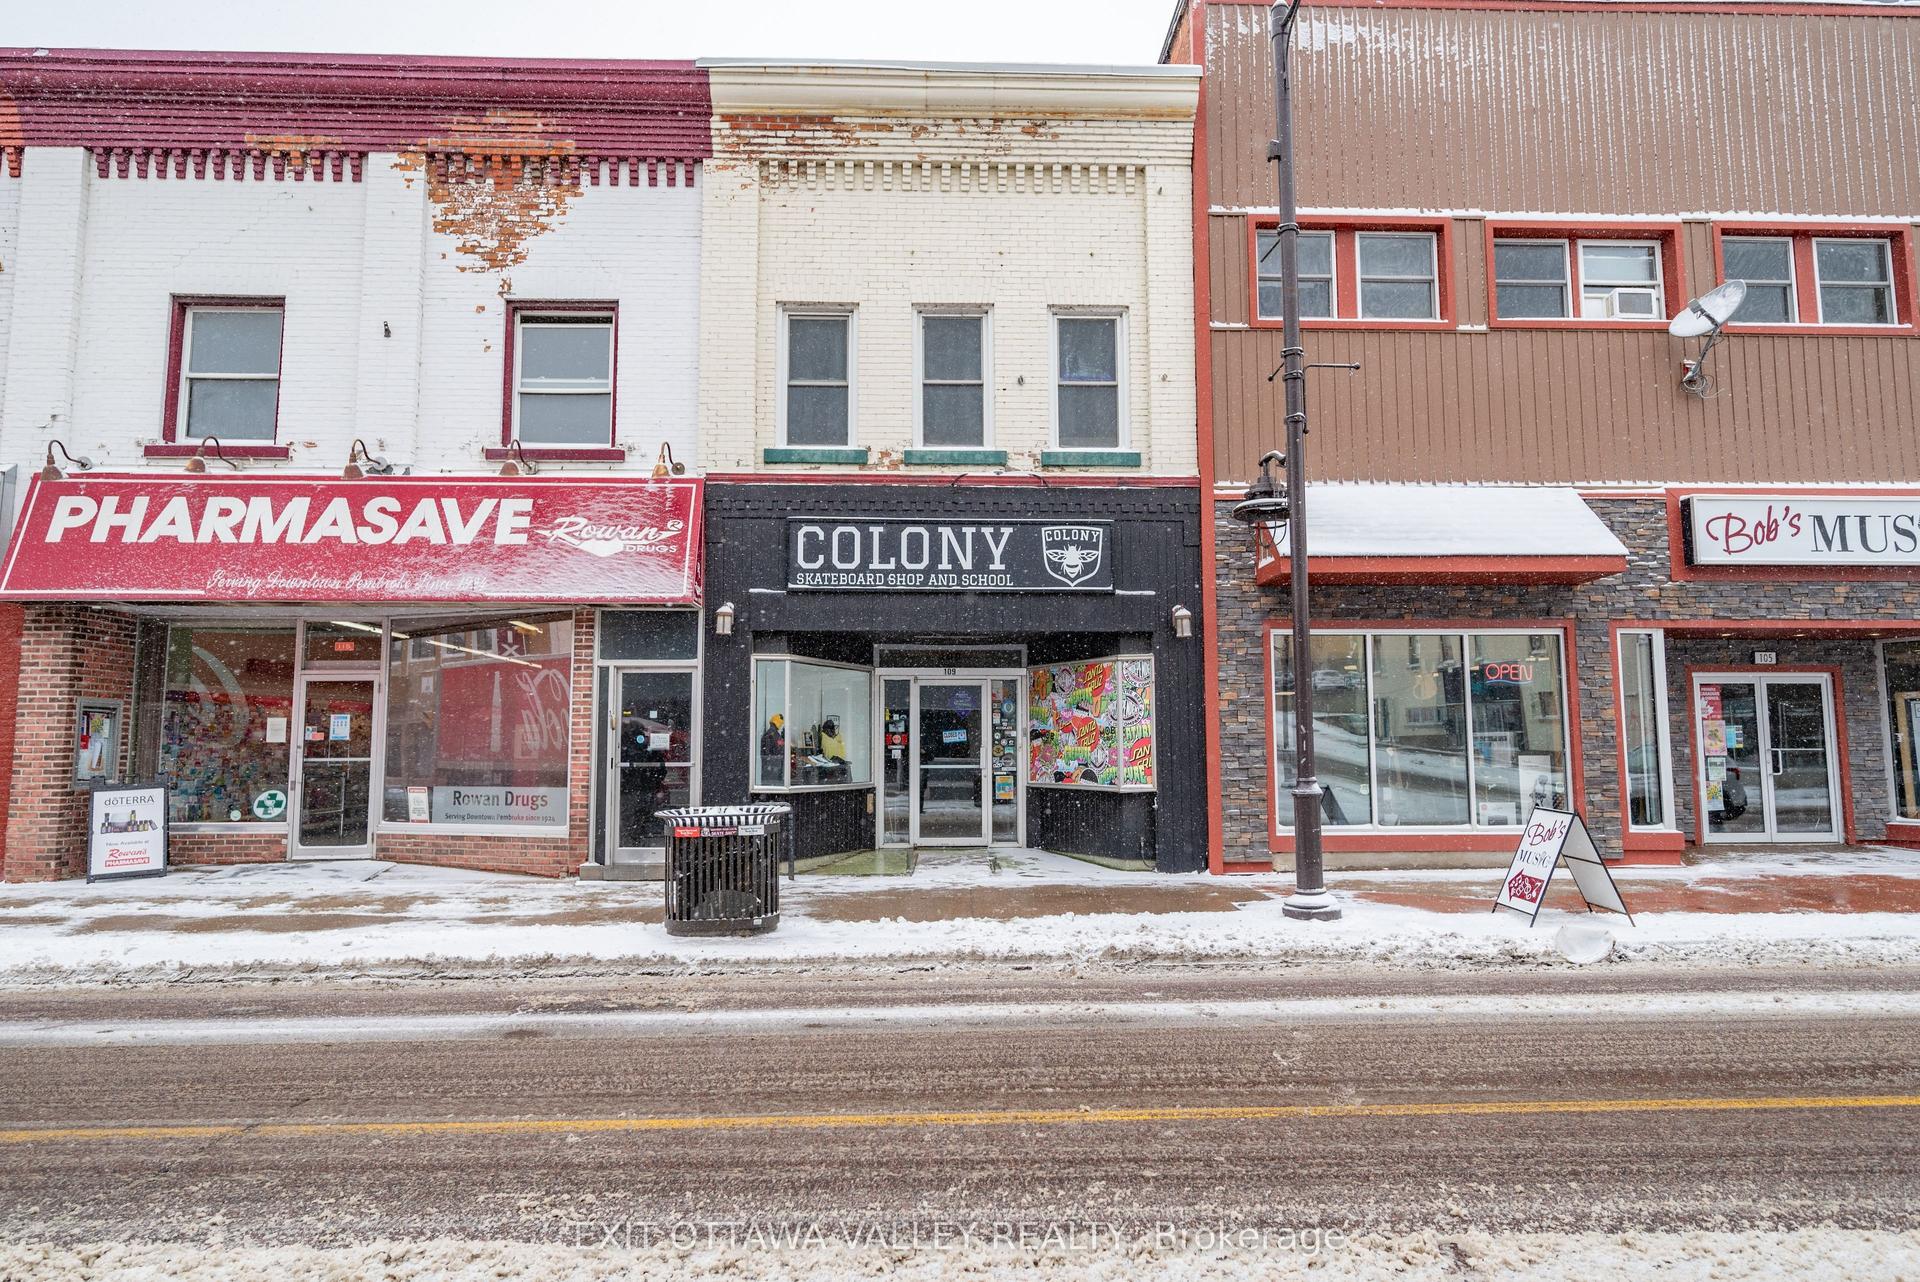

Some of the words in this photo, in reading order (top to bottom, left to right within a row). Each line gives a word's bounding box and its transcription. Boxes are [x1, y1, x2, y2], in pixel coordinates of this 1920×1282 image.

[45, 496, 534, 544] PHARMASAVE
[550, 515, 660, 545] Rowan
[1706, 505, 1801, 555] Bob's
[1808, 514, 1920, 553] MUS
[1045, 529, 1100, 543] COLONY
[626, 544, 677, 552] DRUGS
[797, 526, 1014, 569] COLONY
[207, 569, 260, 596] Serving
[266, 568, 341, 589] Downtown
[345, 571, 411, 589] Pembroke
[796, 573, 884, 586] SKATEBOARD
[888, 574, 924, 586] SHOP
[928, 574, 957, 587] AND
[961, 574, 1014, 587] SCHOOL
[1759, 653, 1773, 663] 105
[1486, 663, 1533, 681] OPEN
[453, 790, 500, 806] Rowan
[505, 791, 548, 811] Drugs
[445, 813, 465, 821] Serving
[467, 813, 496, 821] Downtown
[497, 814, 524, 822] Pembroke
[1528, 819, 1566, 847] Bob's
